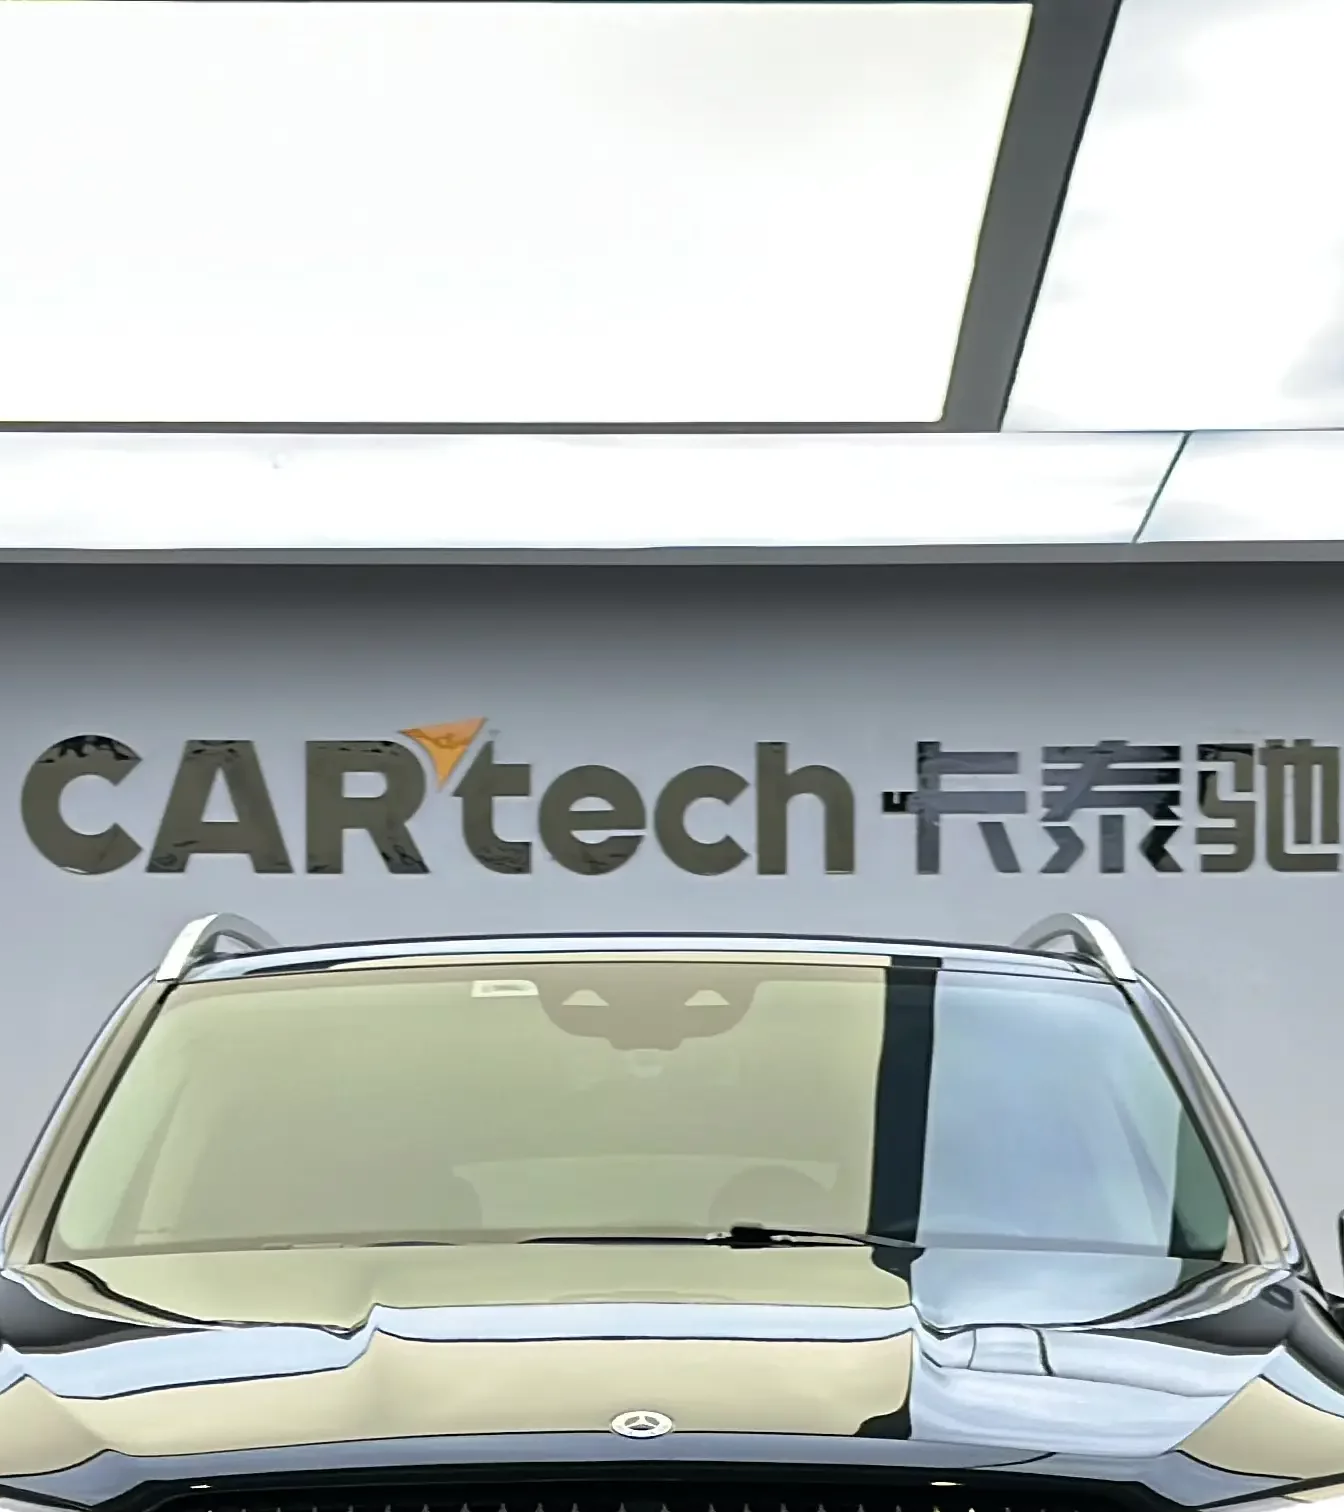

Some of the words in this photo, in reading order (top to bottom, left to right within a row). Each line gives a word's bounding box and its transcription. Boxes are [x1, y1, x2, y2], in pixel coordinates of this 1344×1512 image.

[20, 731, 855, 875] CARtech
[882, 738, 1342, 875] 卡泰驰
